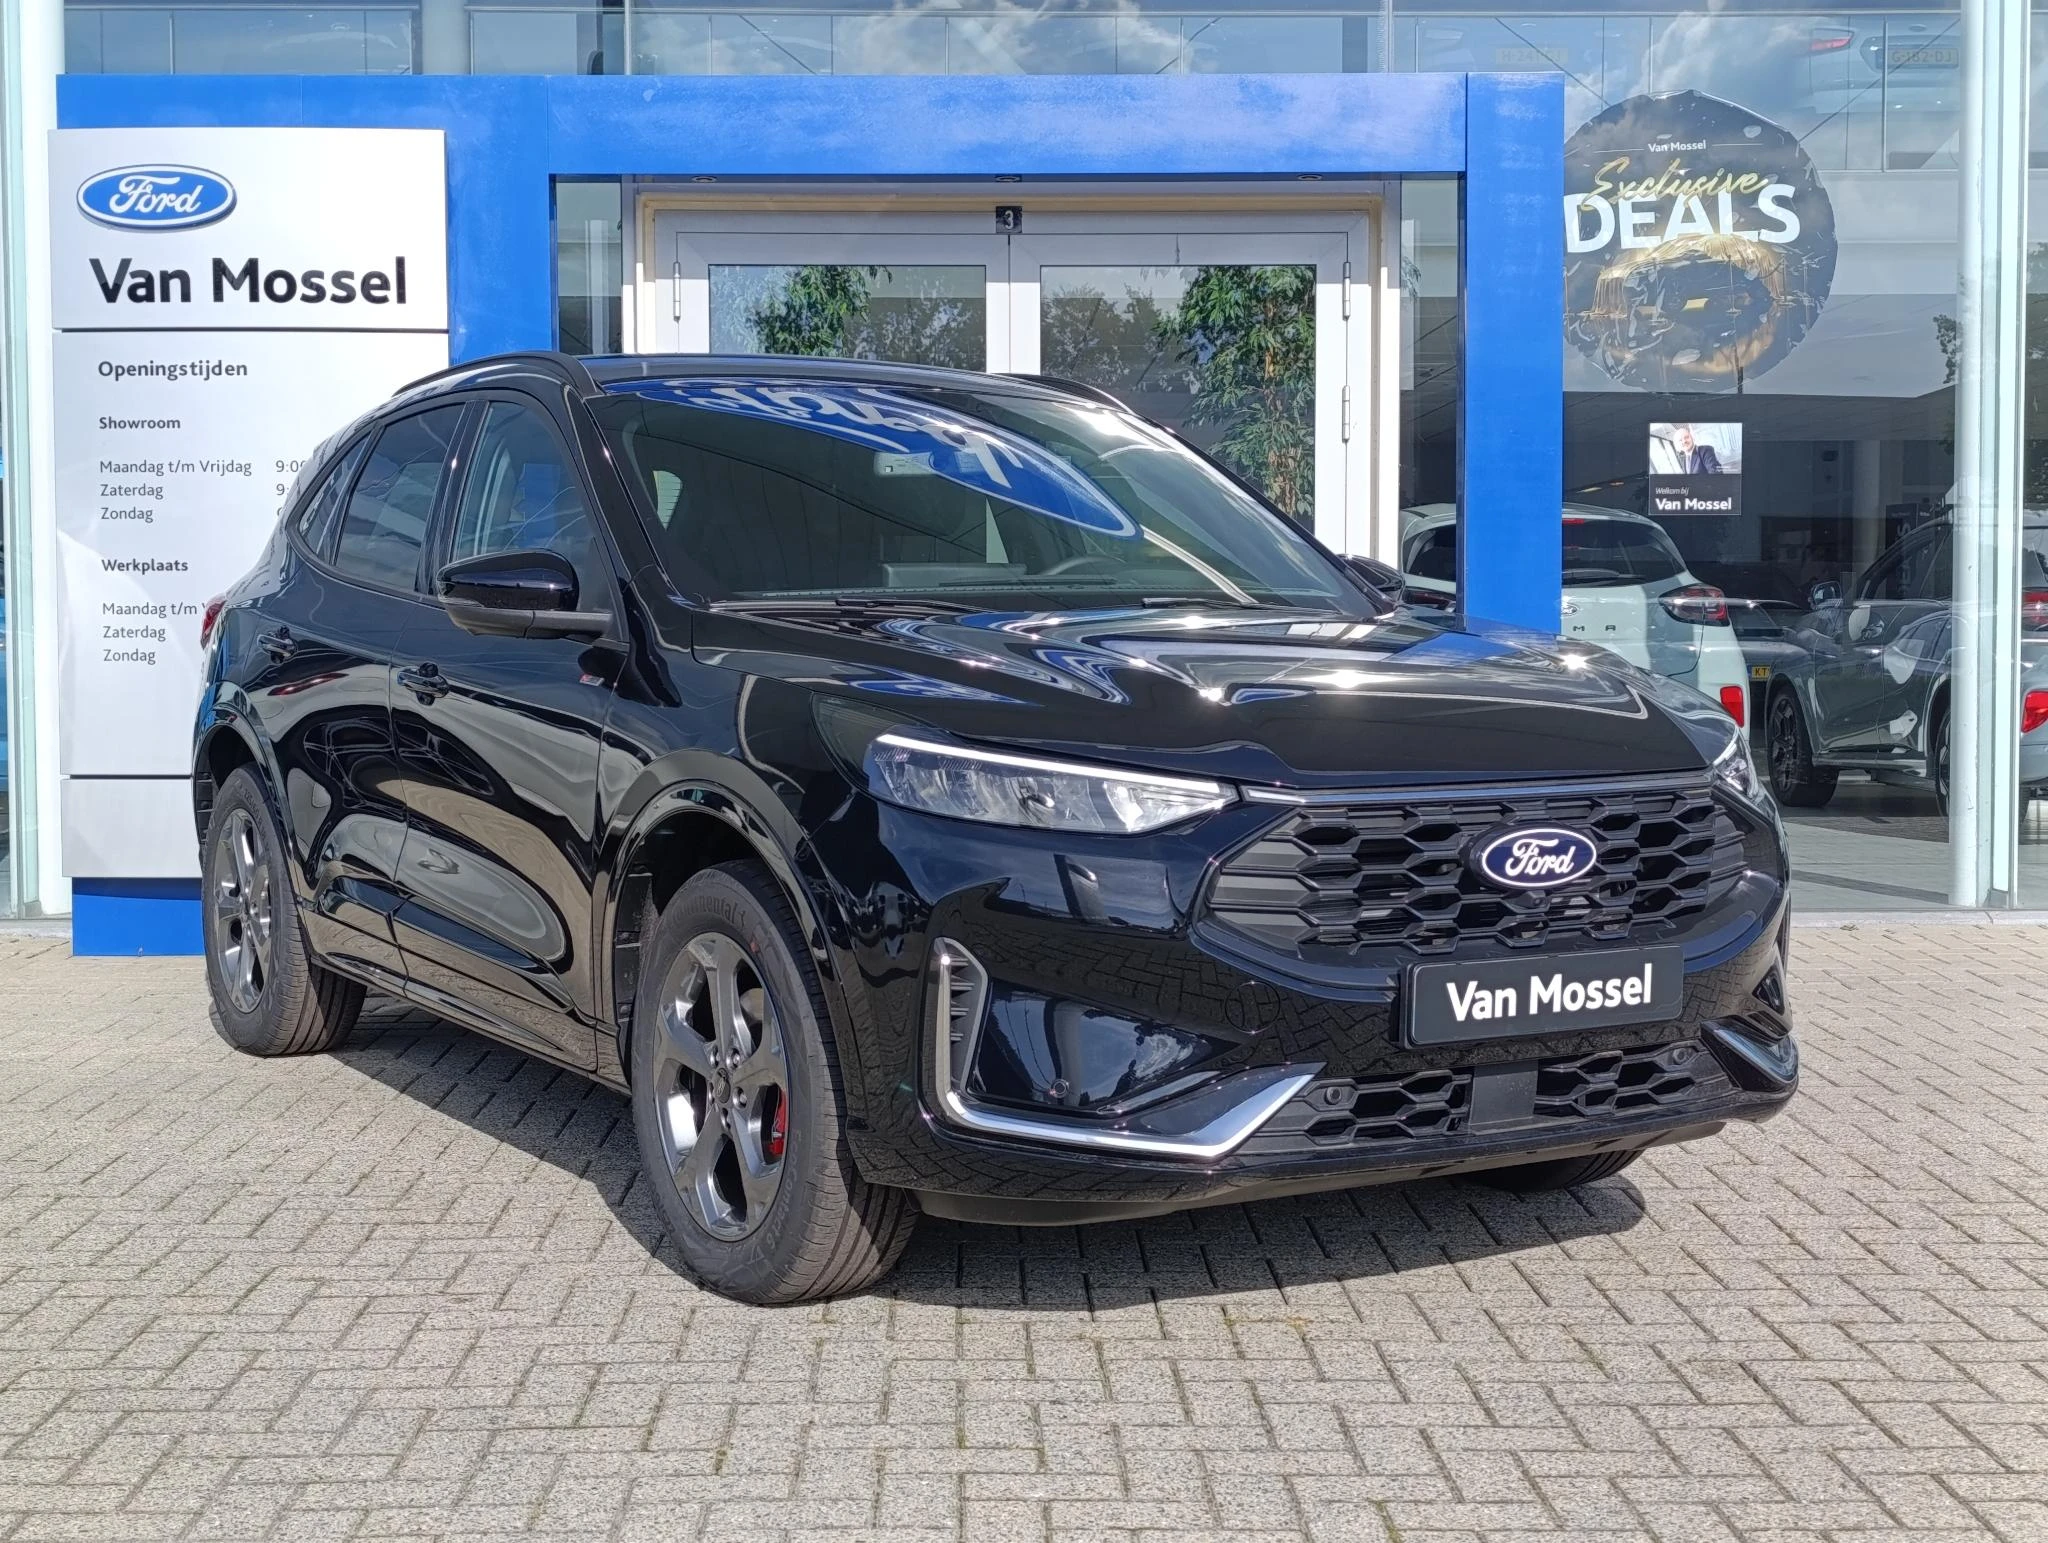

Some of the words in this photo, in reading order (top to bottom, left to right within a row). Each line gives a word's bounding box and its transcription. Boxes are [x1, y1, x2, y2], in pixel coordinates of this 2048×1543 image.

[1648, 143, 1669, 153] Van
[1671, 140, 1706, 152] Mossel
[1580, 156, 1770, 211] Exclusive
[108, 174, 204, 214] Ford
[1004, 210, 1014, 230] 3
[1564, 183, 1801, 253] DEALS
[88, 257, 192, 304] Van
[212, 256, 406, 305] Mossel
[98, 360, 248, 382] Openingstijden
[99, 416, 181, 429] Showroom
[100, 460, 164, 476] Maandag
[168, 460, 195, 473] t/m
[199, 460, 252, 476] Vrijdag
[100, 483, 163, 500] Zaterdag
[1655, 498, 1681, 510] Van
[1685, 497, 1732, 510] Mossel
[101, 507, 153, 523] Zondag
[101, 558, 189, 575] Werkplaats
[102, 602, 167, 618] Maandag
[171, 602, 197, 615] t/m
[103, 625, 166, 641] Zaterdag
[103, 649, 156, 665] Zondag
[1505, 838, 1577, 876] Ford
[1447, 980, 1518, 1022] Van
[1529, 963, 1653, 1016] Mossel
